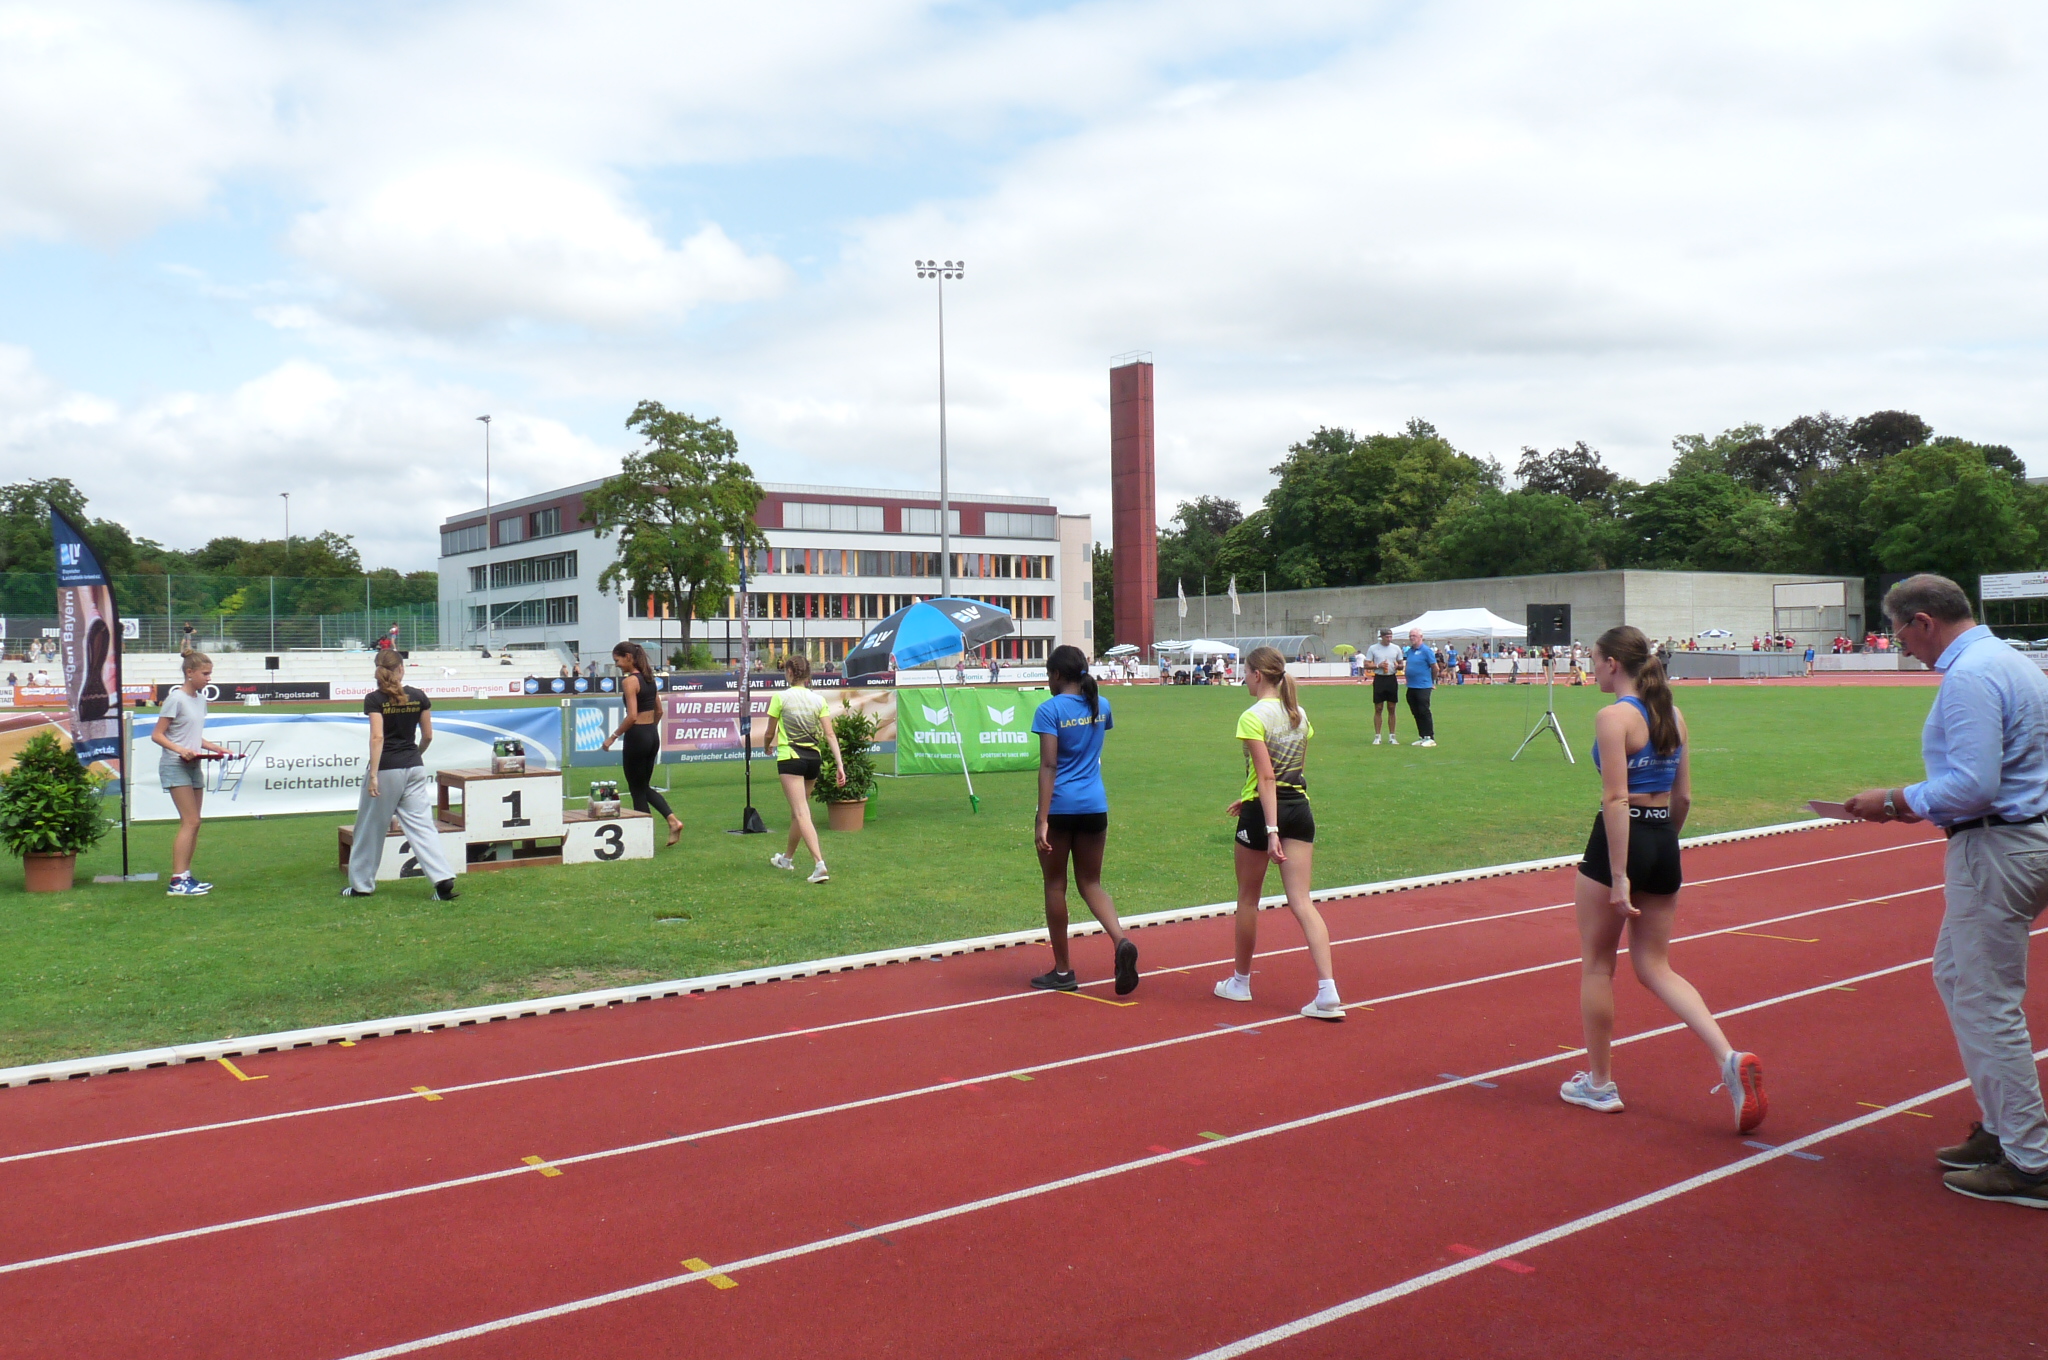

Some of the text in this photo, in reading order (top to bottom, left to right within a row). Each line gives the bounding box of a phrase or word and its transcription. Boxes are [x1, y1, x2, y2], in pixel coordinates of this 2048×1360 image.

[60, 543, 80, 565] BLV
[63, 590, 76, 642] Bayern
[951, 605, 981, 623] BLV
[862, 629, 894, 650] BLV
[823, 678, 840, 686] LOVE
[274, 691, 320, 699] Ingolstadt
[335, 687, 375, 695] Gebäudet
[382, 706, 421, 714] München
[676, 702, 767, 713] WIR BEWEEN
[1060, 718, 1077, 728] LAC
[675, 727, 727, 740] BAYERN
[914, 728, 962, 744] erima
[979, 728, 1028, 744] erima
[265, 754, 360, 771] Bayerischer
[681, 752, 721, 762] Bayerischer
[1627, 756, 1649, 769] LG
[502, 790, 531, 828] 1
[593, 823, 625, 861] 3
